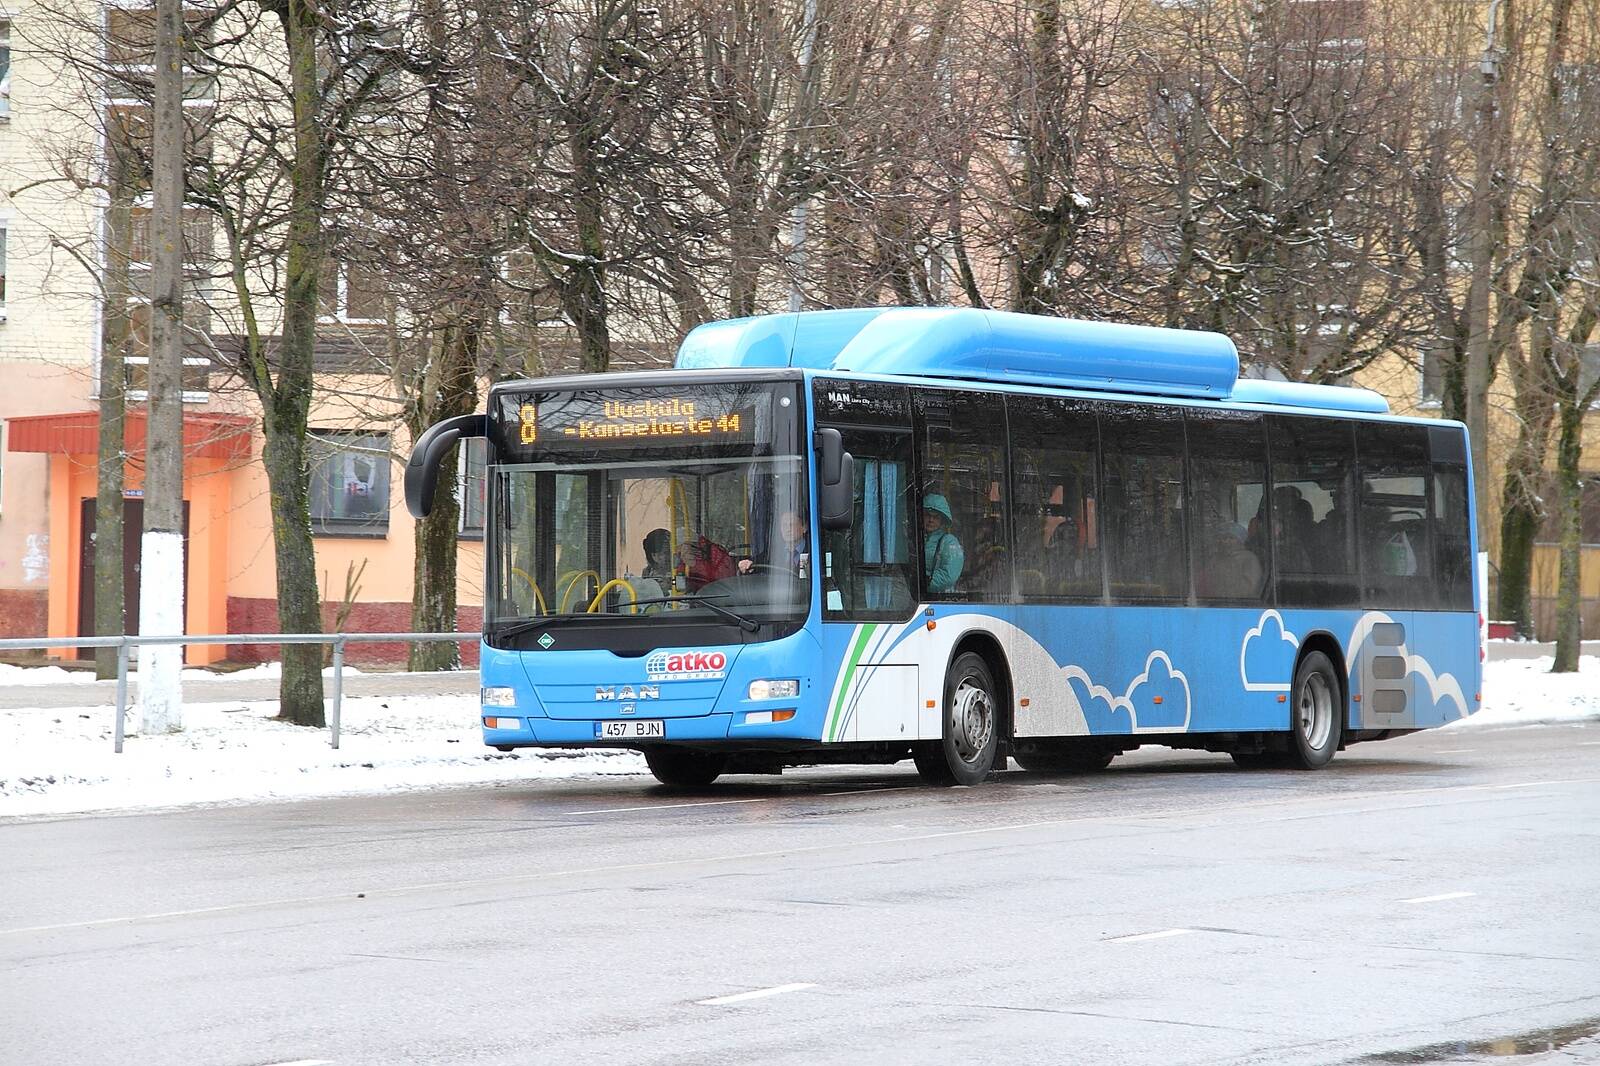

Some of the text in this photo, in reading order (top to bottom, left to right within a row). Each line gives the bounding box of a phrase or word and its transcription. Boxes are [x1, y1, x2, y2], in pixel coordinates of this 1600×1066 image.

[828, 391, 850, 403] MAN
[520, 403, 536, 444] 8
[716, 414, 739, 432] 44
[667, 653, 725, 671] atko
[595, 685, 660, 701] MAN
[607, 722, 660, 736] 457 BJN
